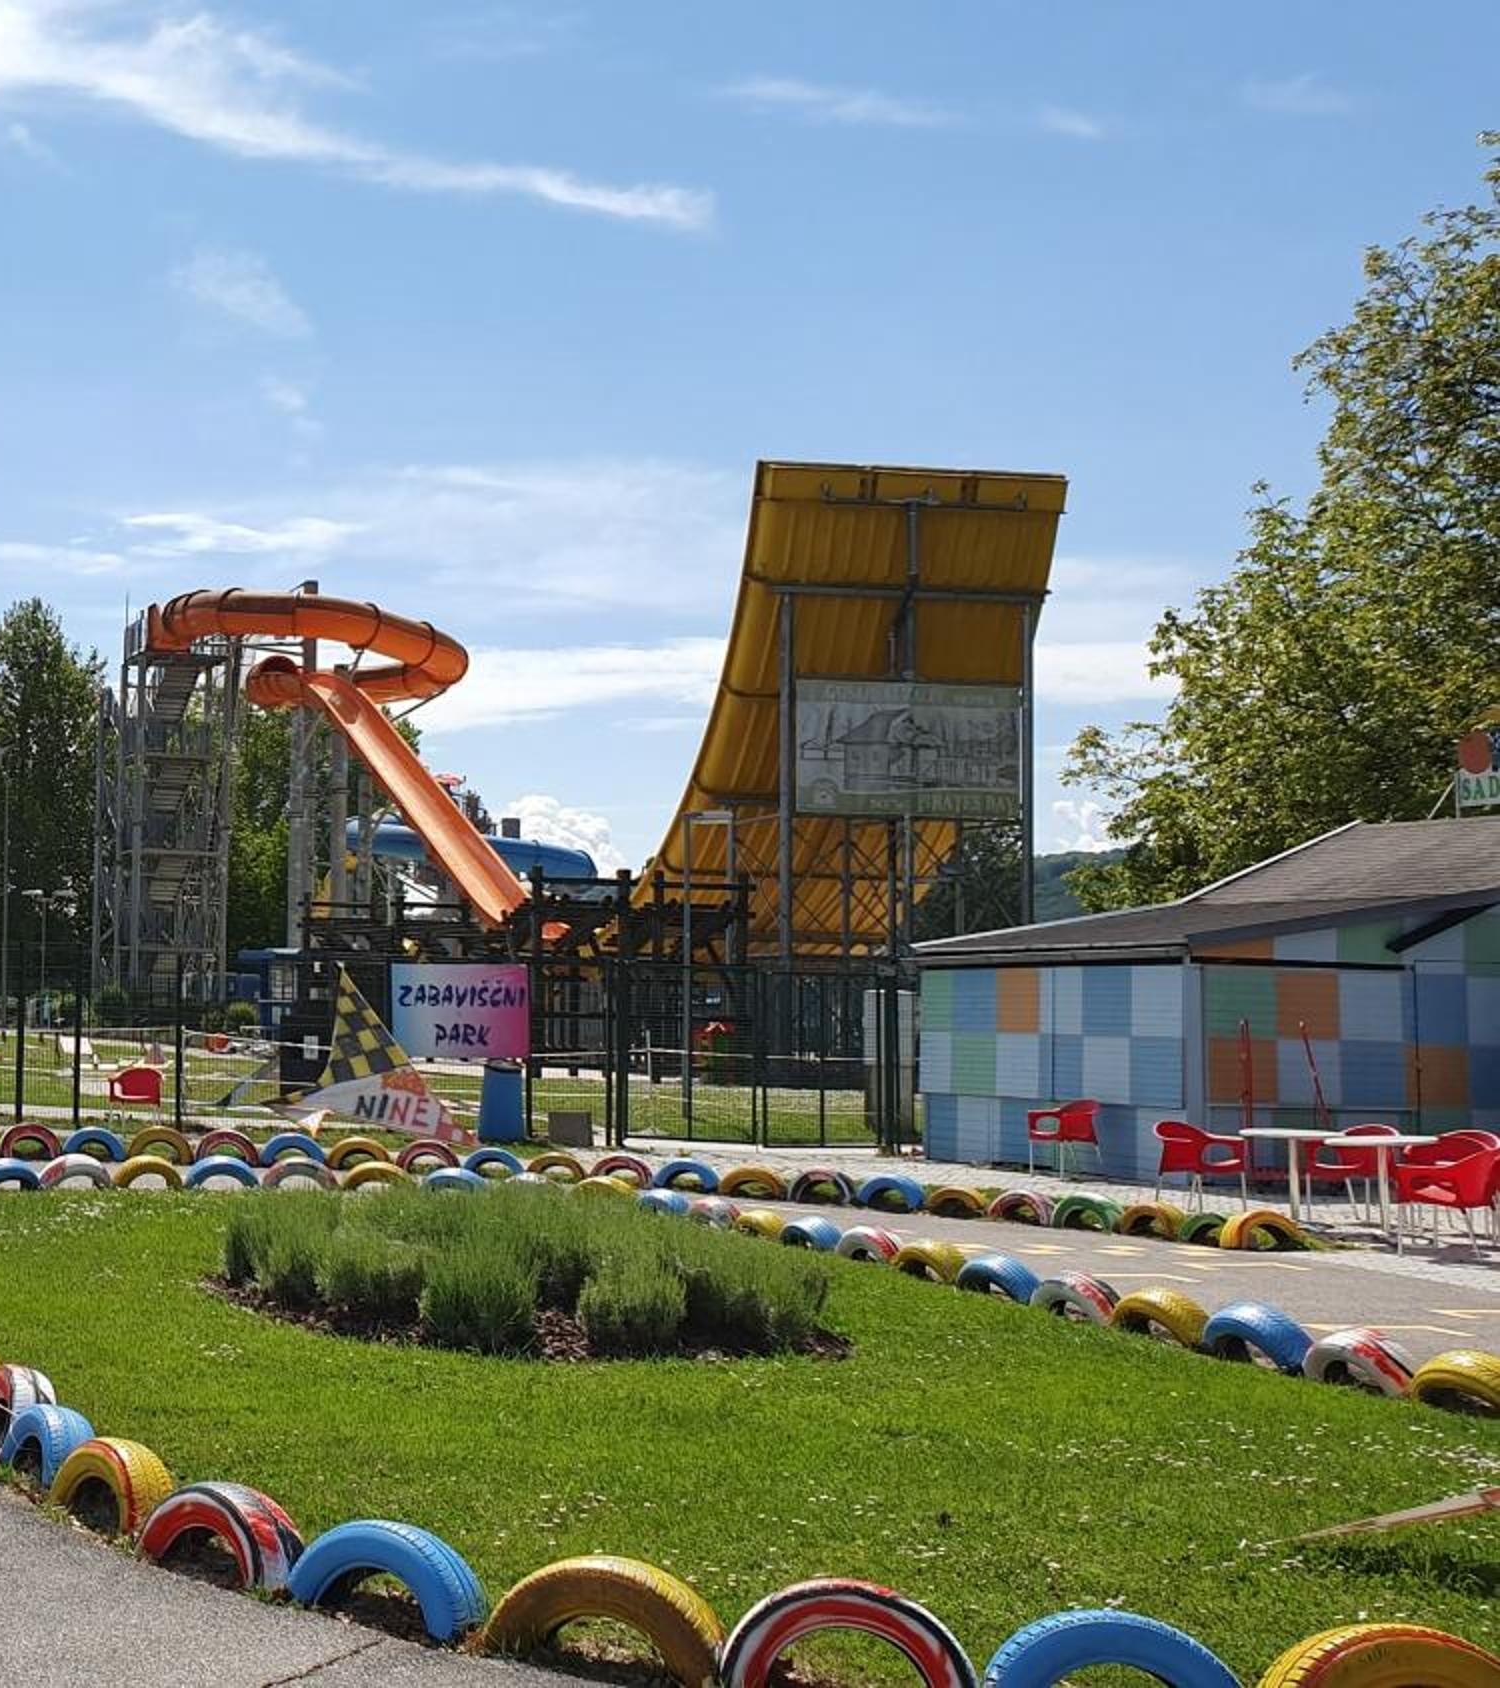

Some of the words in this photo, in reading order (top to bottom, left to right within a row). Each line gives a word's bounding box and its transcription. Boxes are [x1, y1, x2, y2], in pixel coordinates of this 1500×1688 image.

[398, 979, 525, 1008] ZABAVIŠČNI
[434, 1023, 491, 1048] PARK
[354, 1093, 430, 1128] NINE
